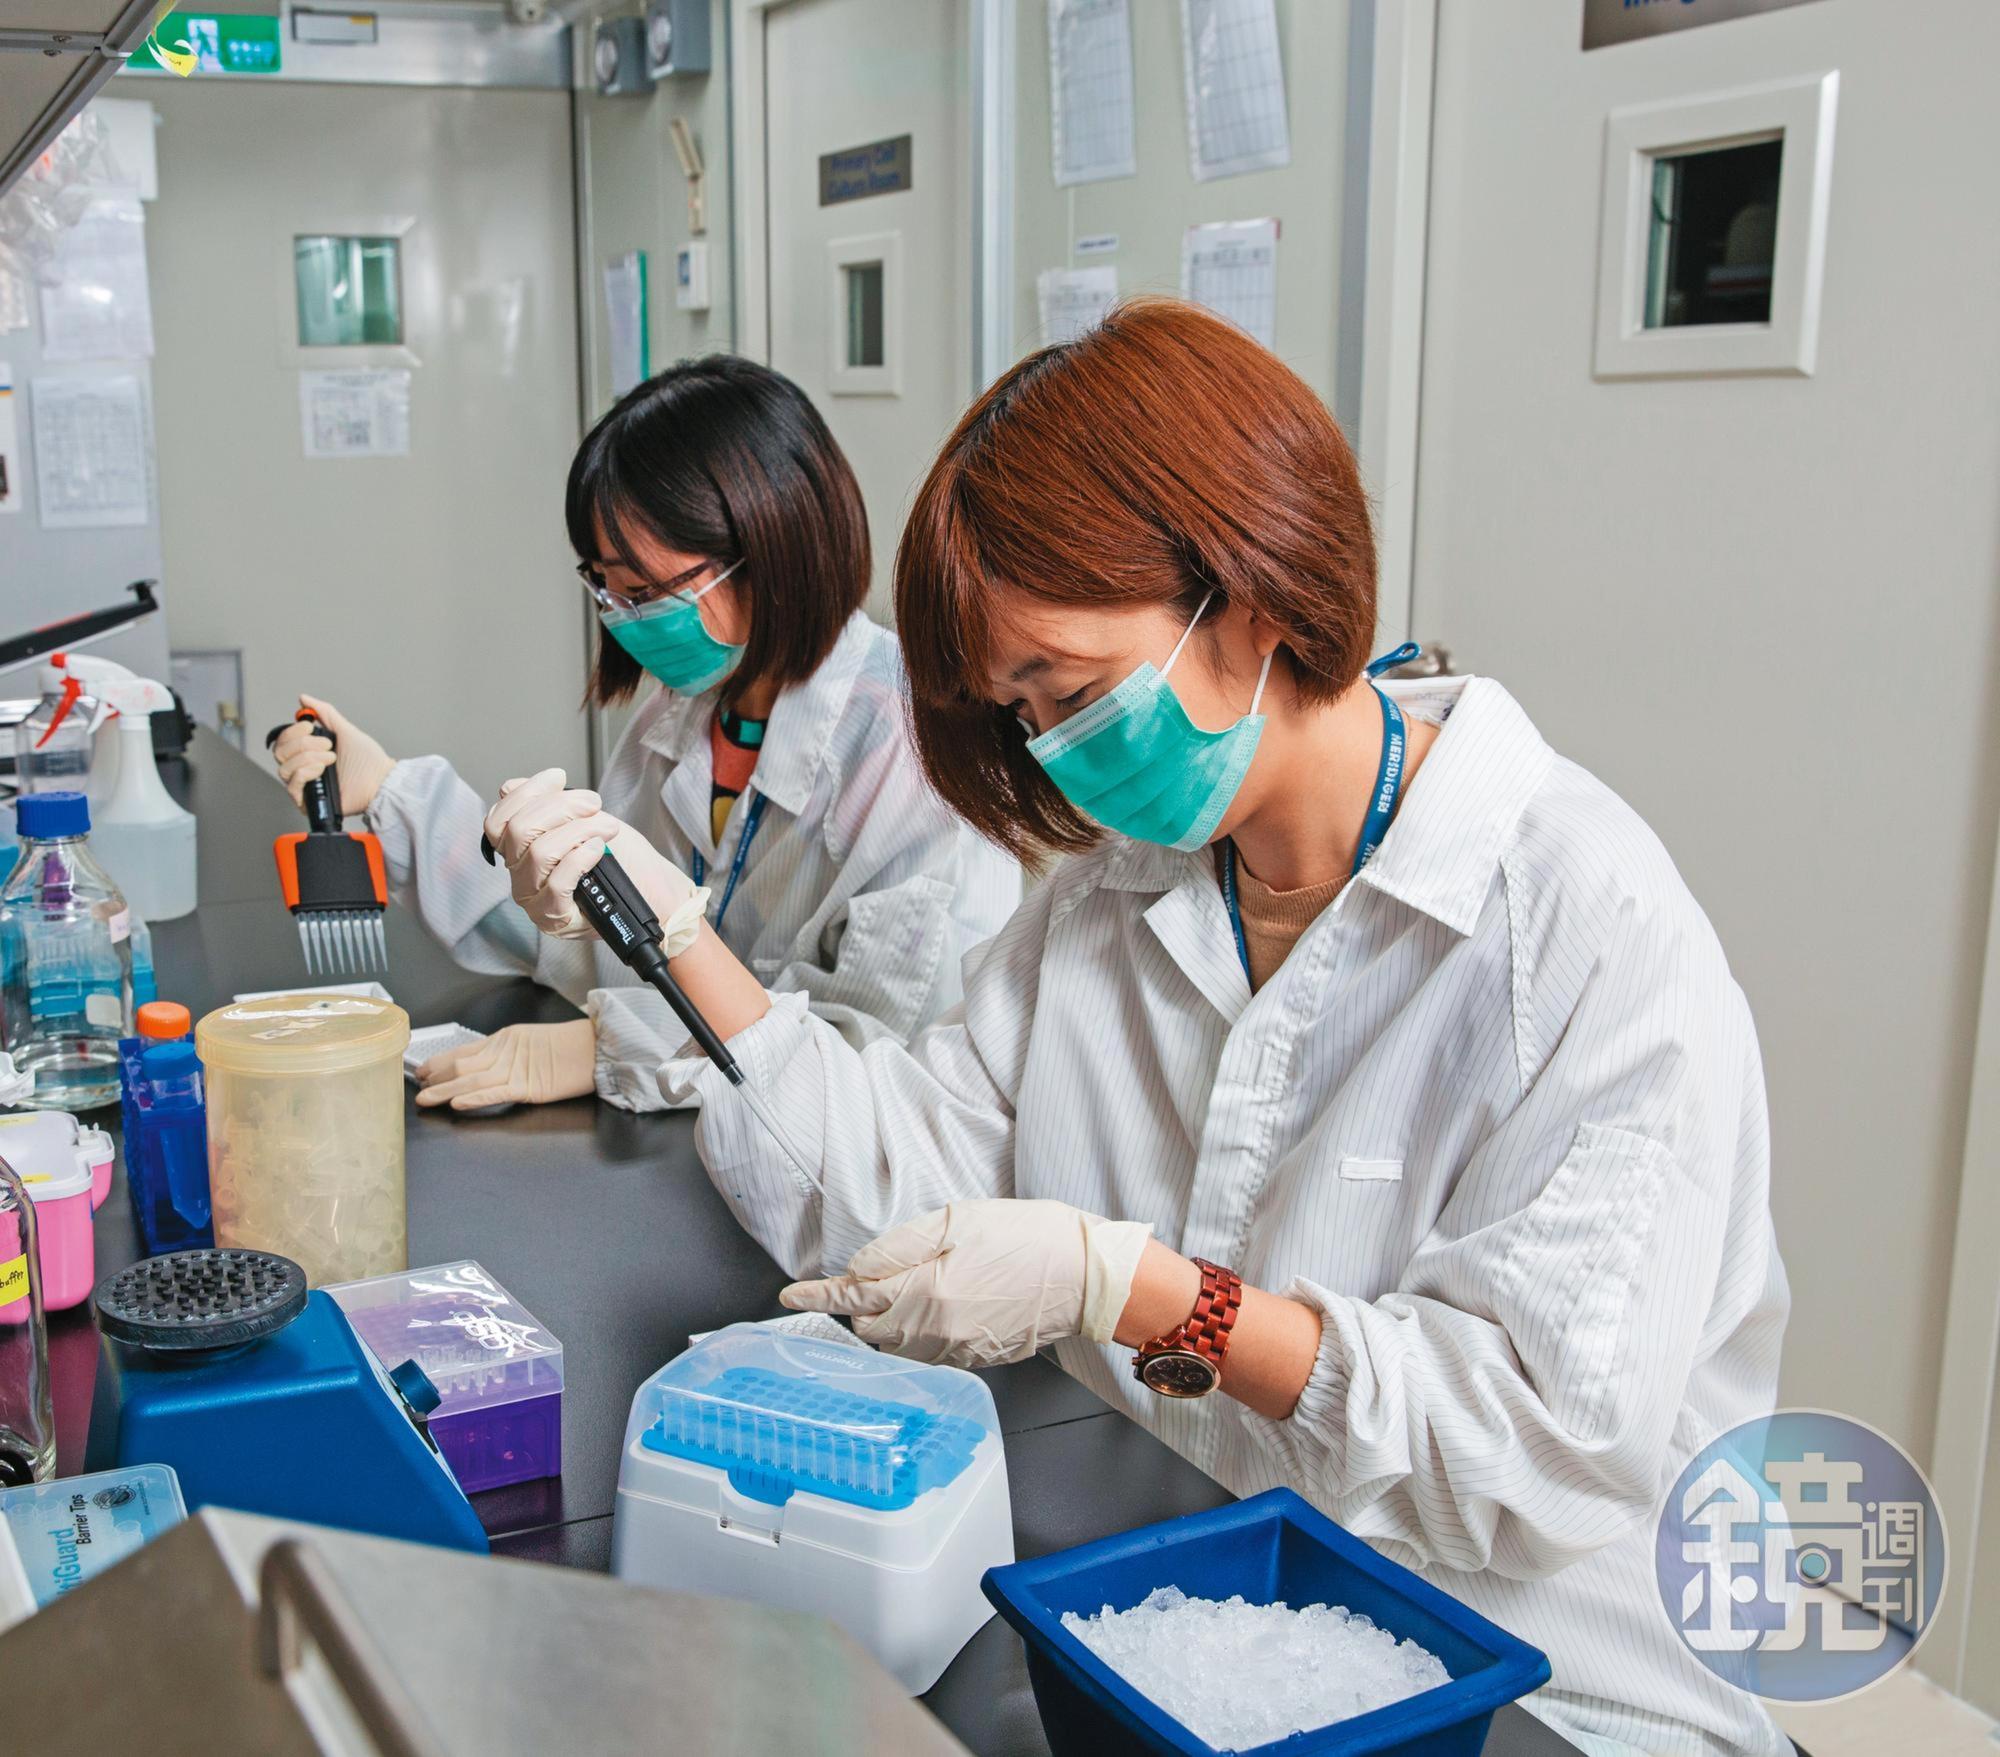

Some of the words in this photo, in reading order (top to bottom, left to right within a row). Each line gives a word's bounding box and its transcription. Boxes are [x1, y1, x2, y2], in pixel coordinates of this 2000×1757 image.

[1377, 733, 1403, 813] MERIDIGEN
[610, 914, 631, 945] Thermo
[69, 1494, 88, 1513] Tips
[72, 1514, 92, 1545] Barrier
